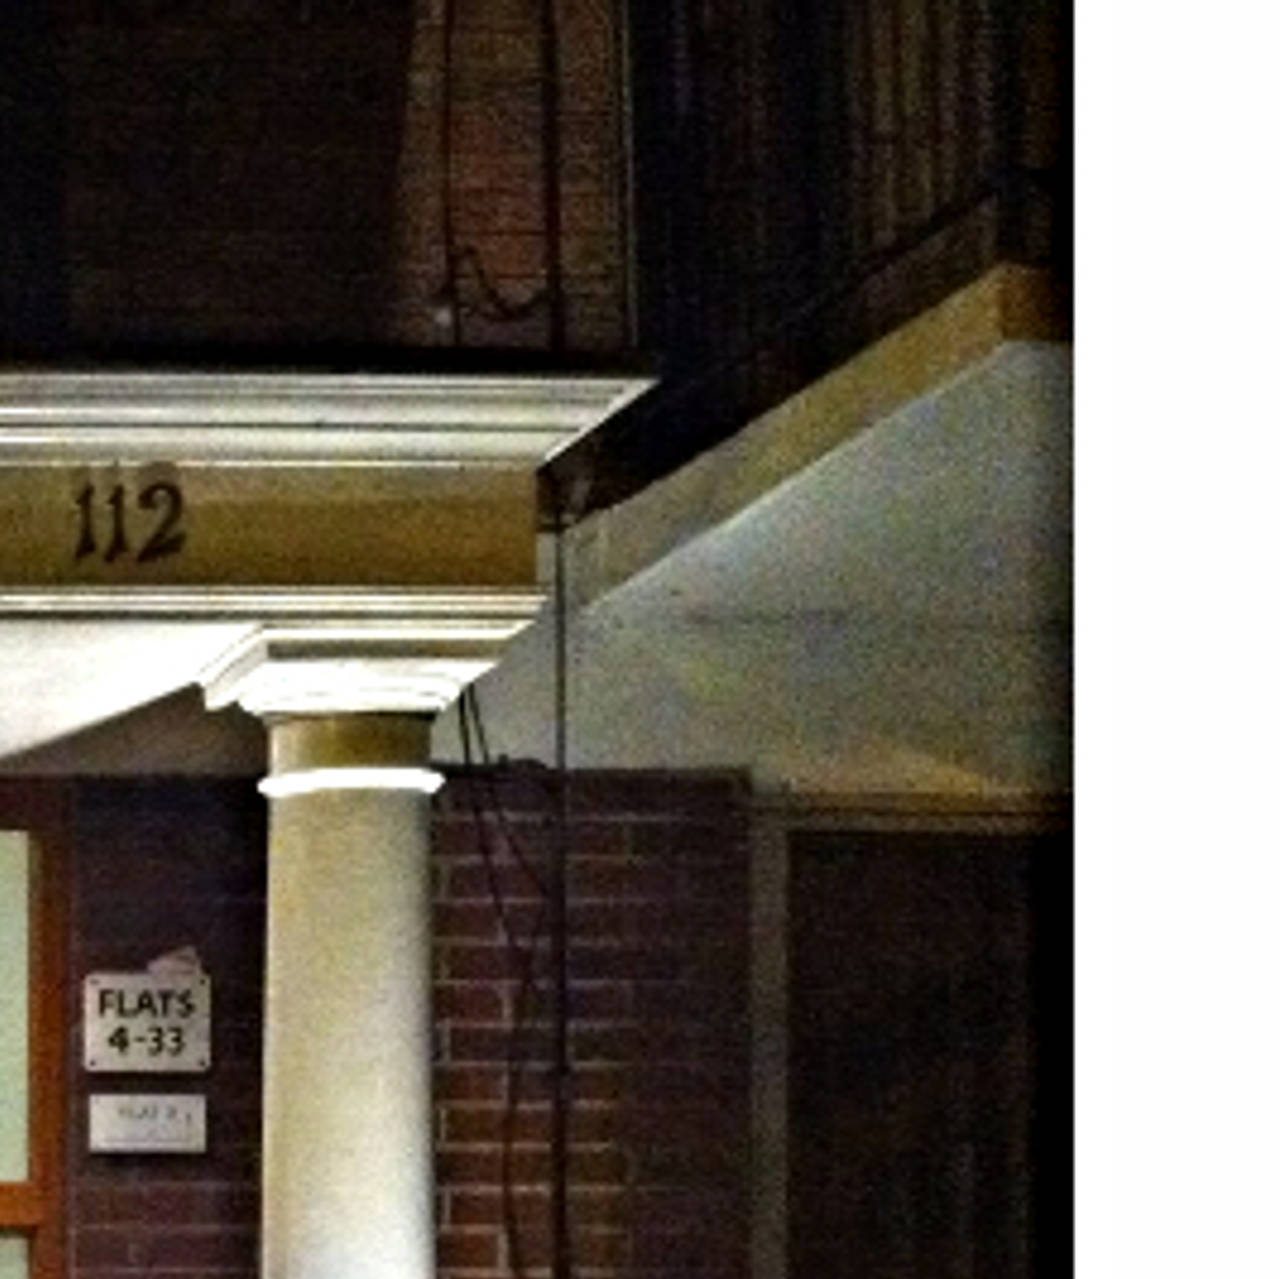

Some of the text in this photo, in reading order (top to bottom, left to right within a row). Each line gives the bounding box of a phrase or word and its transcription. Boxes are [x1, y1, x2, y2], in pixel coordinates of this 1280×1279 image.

[73, 479, 188, 564] 112
[97, 988, 196, 1019] FLATS
[107, 1025, 186, 1057] 4-33
